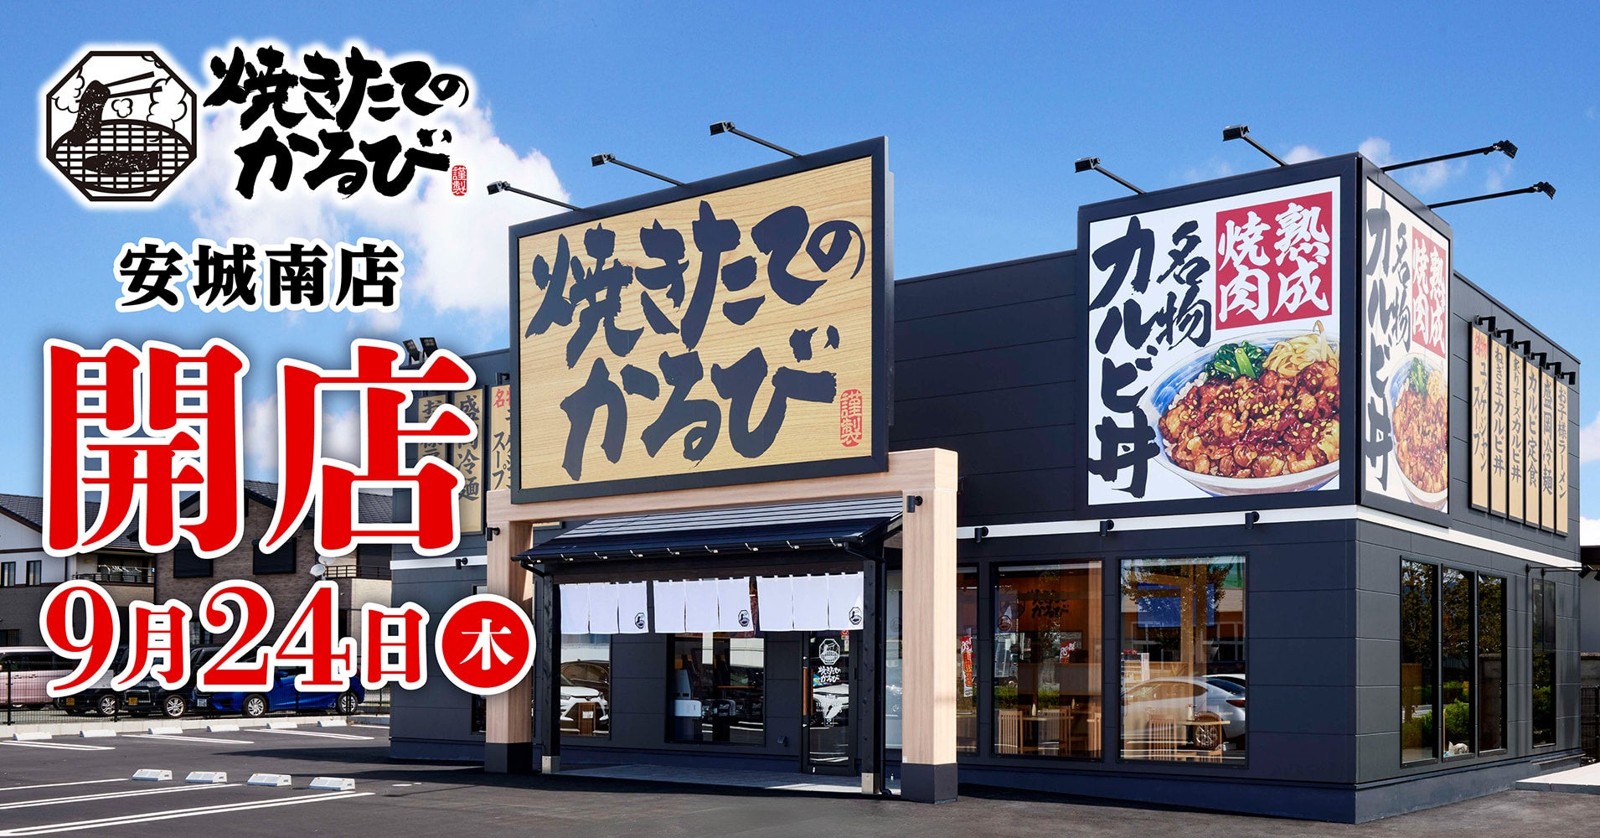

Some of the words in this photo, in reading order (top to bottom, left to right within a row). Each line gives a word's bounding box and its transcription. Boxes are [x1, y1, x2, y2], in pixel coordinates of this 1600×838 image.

[525, 200, 866, 369] 焼きたての
[1155, 220, 1212, 351] 名物
[1218, 211, 1271, 323] 焼肉
[1272, 202, 1331, 317] 熟成
[1388, 222, 1411, 353] 名物
[1412, 237, 1429, 341] 焼肉
[1429, 247, 1446, 351] 熟成
[561, 325, 838, 482] かるび
[1089, 215, 1161, 499] カルビ丼
[1366, 192, 1394, 491] カルビ丼
[492, 431, 507, 491] スープ
